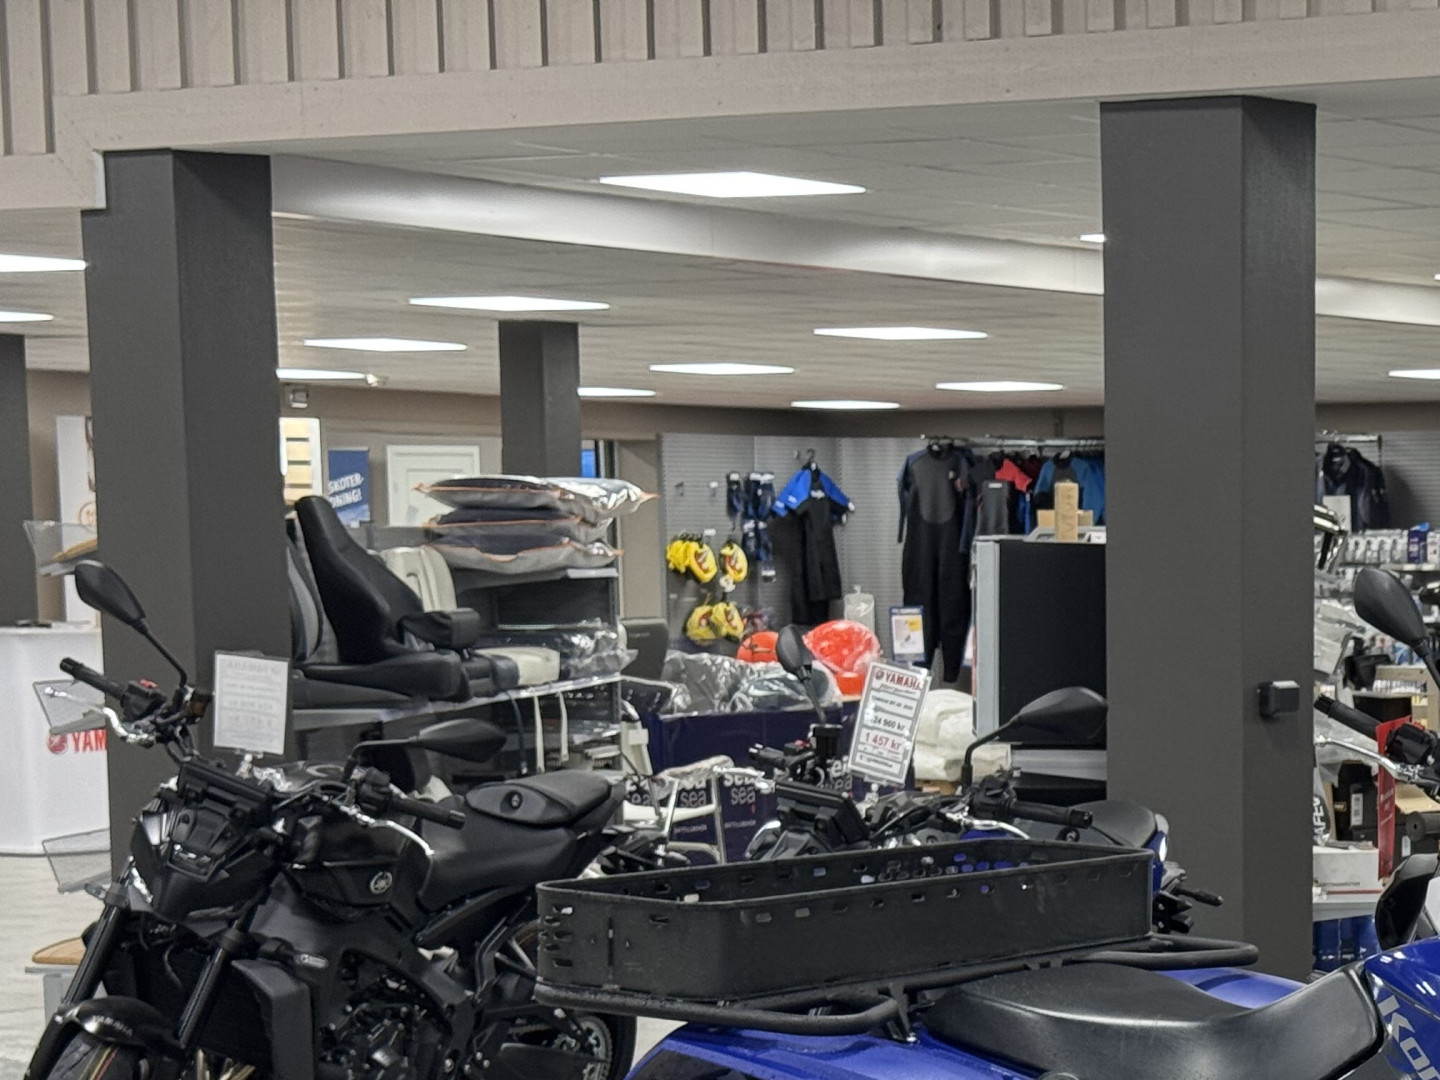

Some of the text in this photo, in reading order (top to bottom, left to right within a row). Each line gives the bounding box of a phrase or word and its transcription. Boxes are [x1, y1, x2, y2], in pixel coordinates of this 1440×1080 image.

[865, 732, 902, 751] 1 457 kr
[680, 789, 707, 807] sea
[730, 786, 756, 806] sea
